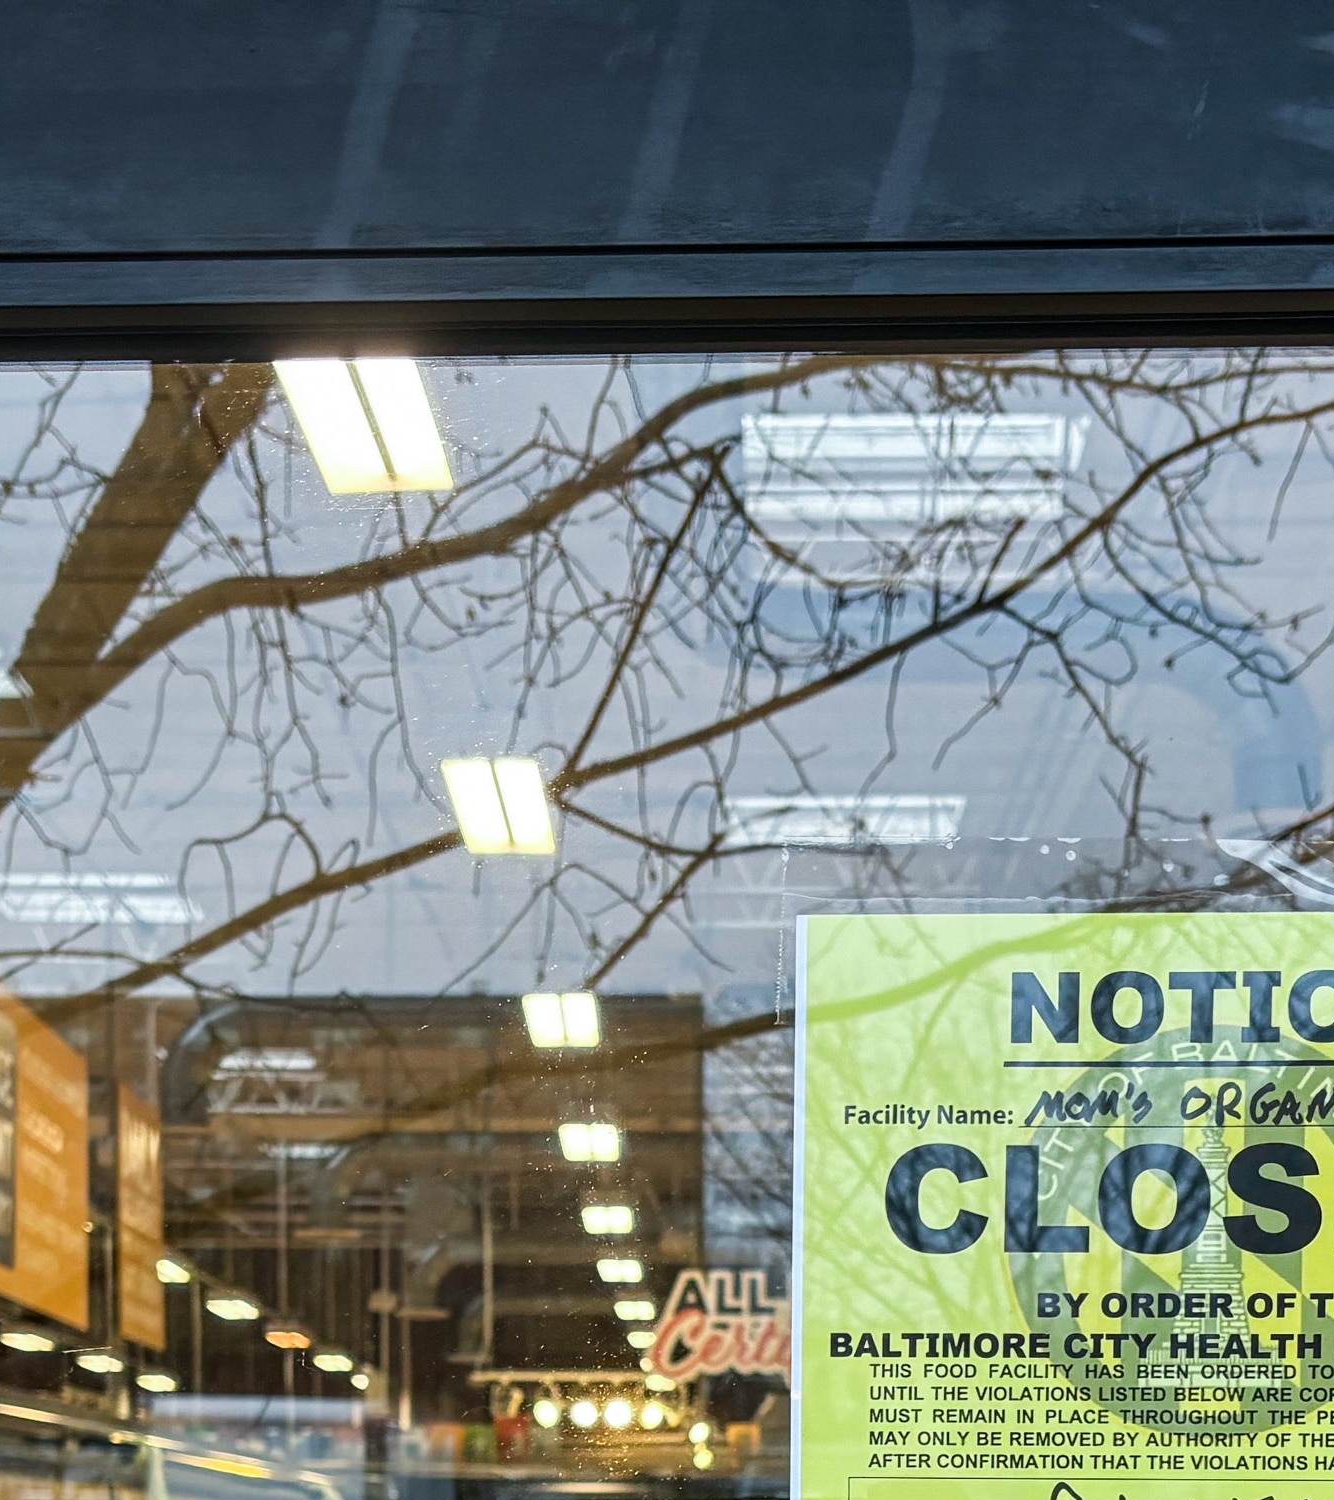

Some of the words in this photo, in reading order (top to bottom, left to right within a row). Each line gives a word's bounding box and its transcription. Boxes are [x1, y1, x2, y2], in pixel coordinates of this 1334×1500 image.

[844, 1104, 930, 1130] Facility
[937, 1105, 1013, 1125] Name:
[1037, 1292, 1089, 1319] BY
[1101, 1292, 1234, 1319] ORDER
[1246, 1292, 1297, 1319] OF
[830, 1332, 1051, 1359] BALTIMORE
[1063, 1332, 1157, 1359] CITY
[1169, 1333, 1322, 1360] HEALTH
[869, 1363, 912, 1378] THIS
[924, 1363, 977, 1379] FOOD
[989, 1363, 1074, 1379] FACILITY
[1085, 1363, 1125, 1379] HAS
[1136, 1364, 1189, 1379] BEEN
[1200, 1364, 1297, 1380] ORDERED
[1307, 1364, 1334, 1380] TO
[870, 1386, 924, 1401] UNTIL
[931, 1386, 968, 1401] THE
[975, 1386, 1092, 1402] VIOLATIONS
[1098, 1386, 1166, 1402] LISTED
[1173, 1386, 1246, 1402] BELOW
[1251, 1387, 1293, 1403] ARE
[869, 1408, 922, 1423] MUST
[932, 1408, 1006, 1424] REMAIN
[1017, 1409, 1034, 1424] IN
[1045, 1409, 1110, 1424] PLACE
[1119, 1409, 1259, 1425] THROUGHOUT
[1266, 1409, 1306, 1425] THE
[869, 1431, 911, 1446] MAY
[917, 1431, 970, 1446] ONLY
[977, 1431, 1002, 1446] BE
[1009, 1431, 1105, 1447] REMOVED
[1113, 1432, 1139, 1447] BY
[1145, 1432, 1259, 1448] AUTHORITY
[1265, 1432, 1292, 1448] OF
[868, 1453, 931, 1468] AFTER
[937, 1453, 1084, 1469] CONFIRMATION
[1089, 1454, 1142, 1470] THAT
[1146, 1455, 1185, 1470] THE
[1190, 1455, 1308, 1471] VIOLATIONS
